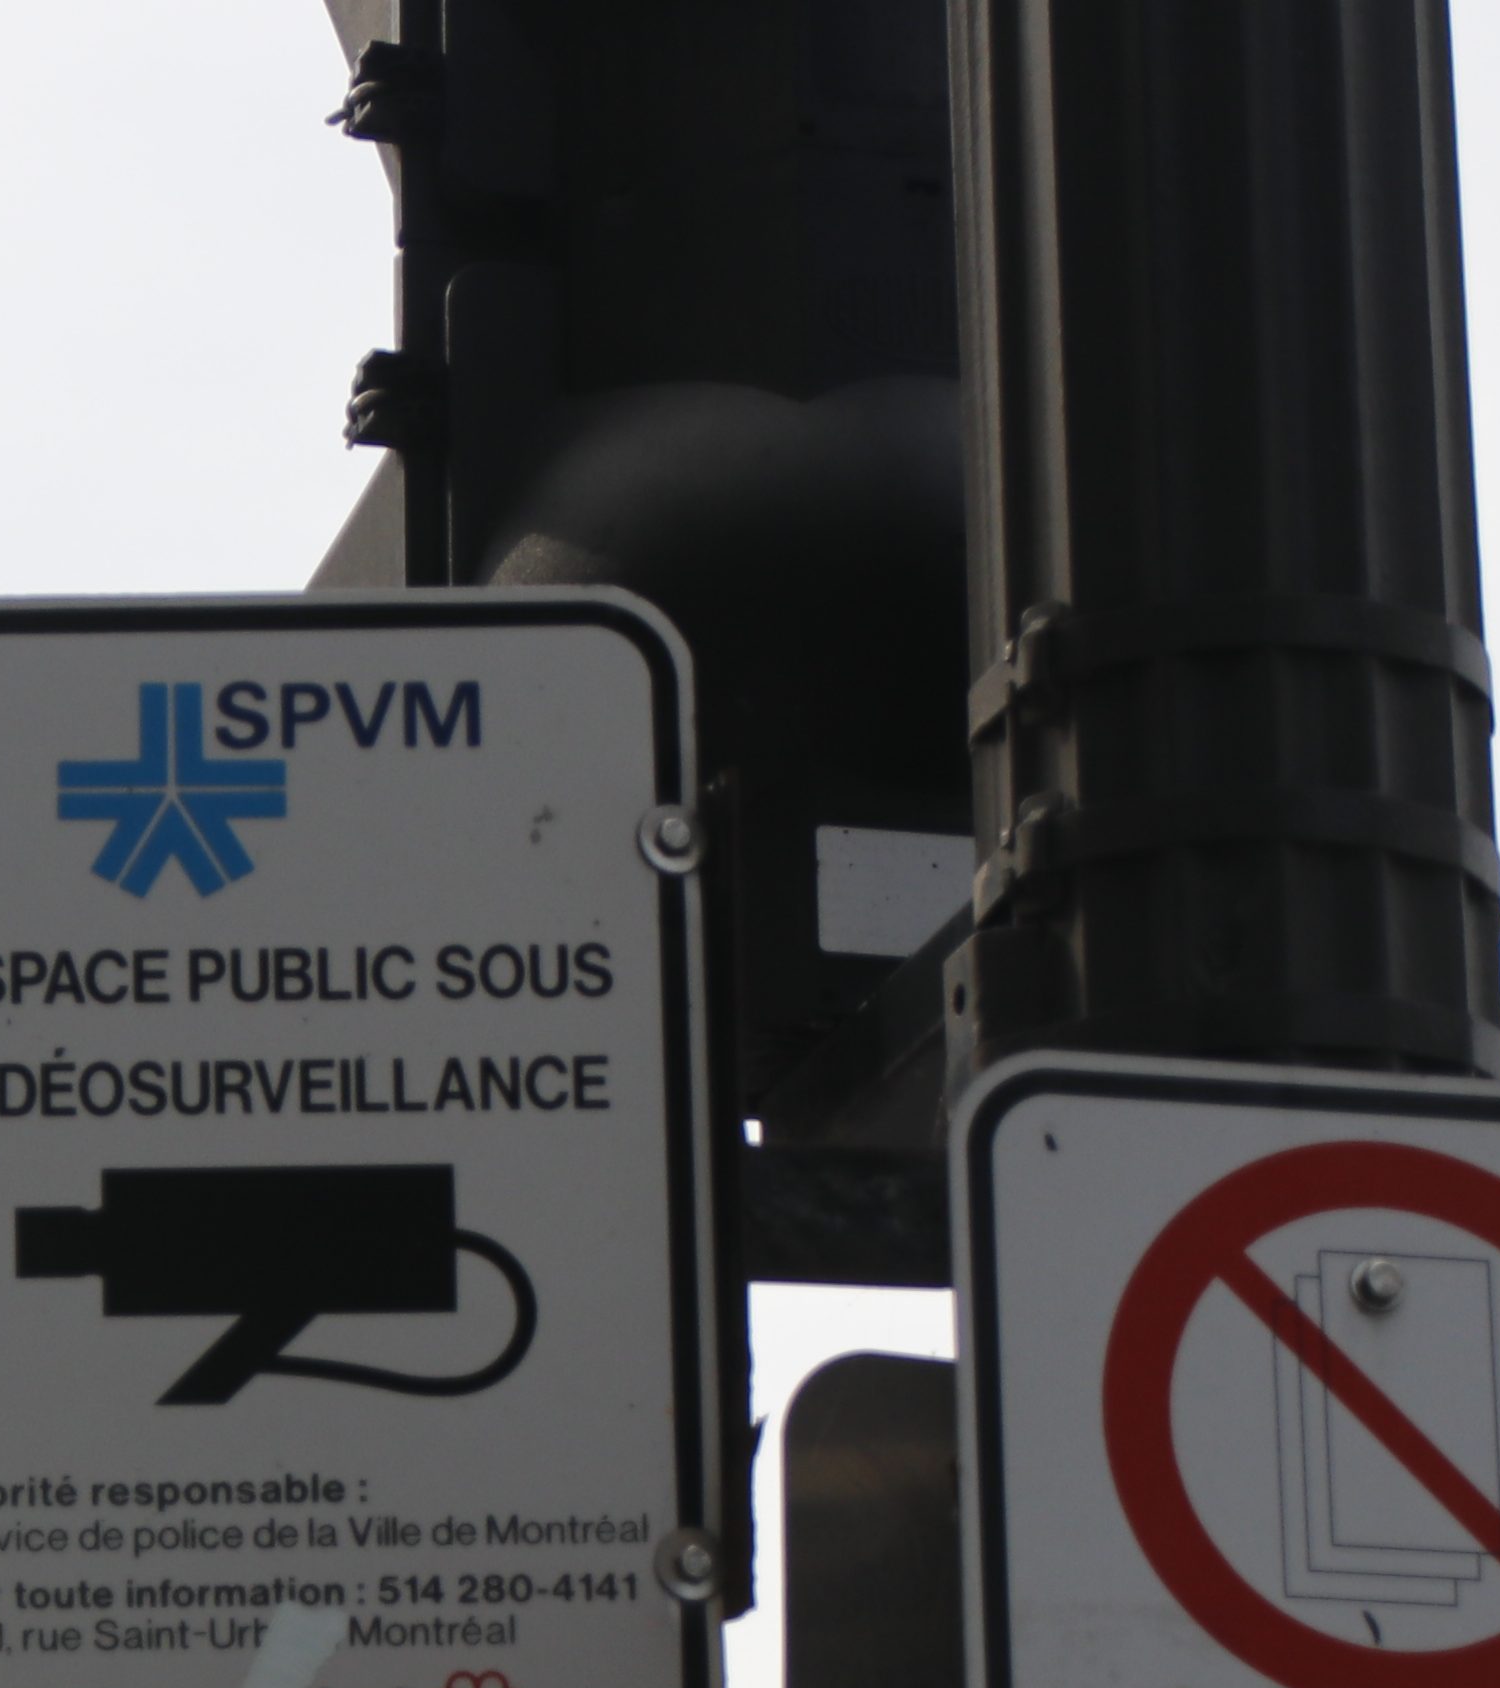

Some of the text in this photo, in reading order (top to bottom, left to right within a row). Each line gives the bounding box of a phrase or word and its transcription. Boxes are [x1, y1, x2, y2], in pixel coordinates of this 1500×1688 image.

[214, 679, 482, 752] SPVM
[187, 944, 417, 1004] PUBLIC
[435, 941, 615, 1001] SOUS
[90, 1472, 347, 1514] responsable
[77, 1519, 125, 1553] de
[132, 1518, 245, 1559] police
[251, 1517, 300, 1551] de
[306, 1516, 339, 1549] la
[347, 1515, 423, 1549] Ville
[430, 1515, 478, 1548] de
[484, 1512, 651, 1546] Montréal
[13, 1579, 115, 1611] toute
[125, 1577, 346, 1609] information
[378, 1574, 445, 1606] 514
[457, 1571, 638, 1606] 280-4141
[21, 1626, 83, 1653] rue
[93, 1617, 270, 1653] Saint-Ur
[347, 1613, 517, 1648] Montréal
